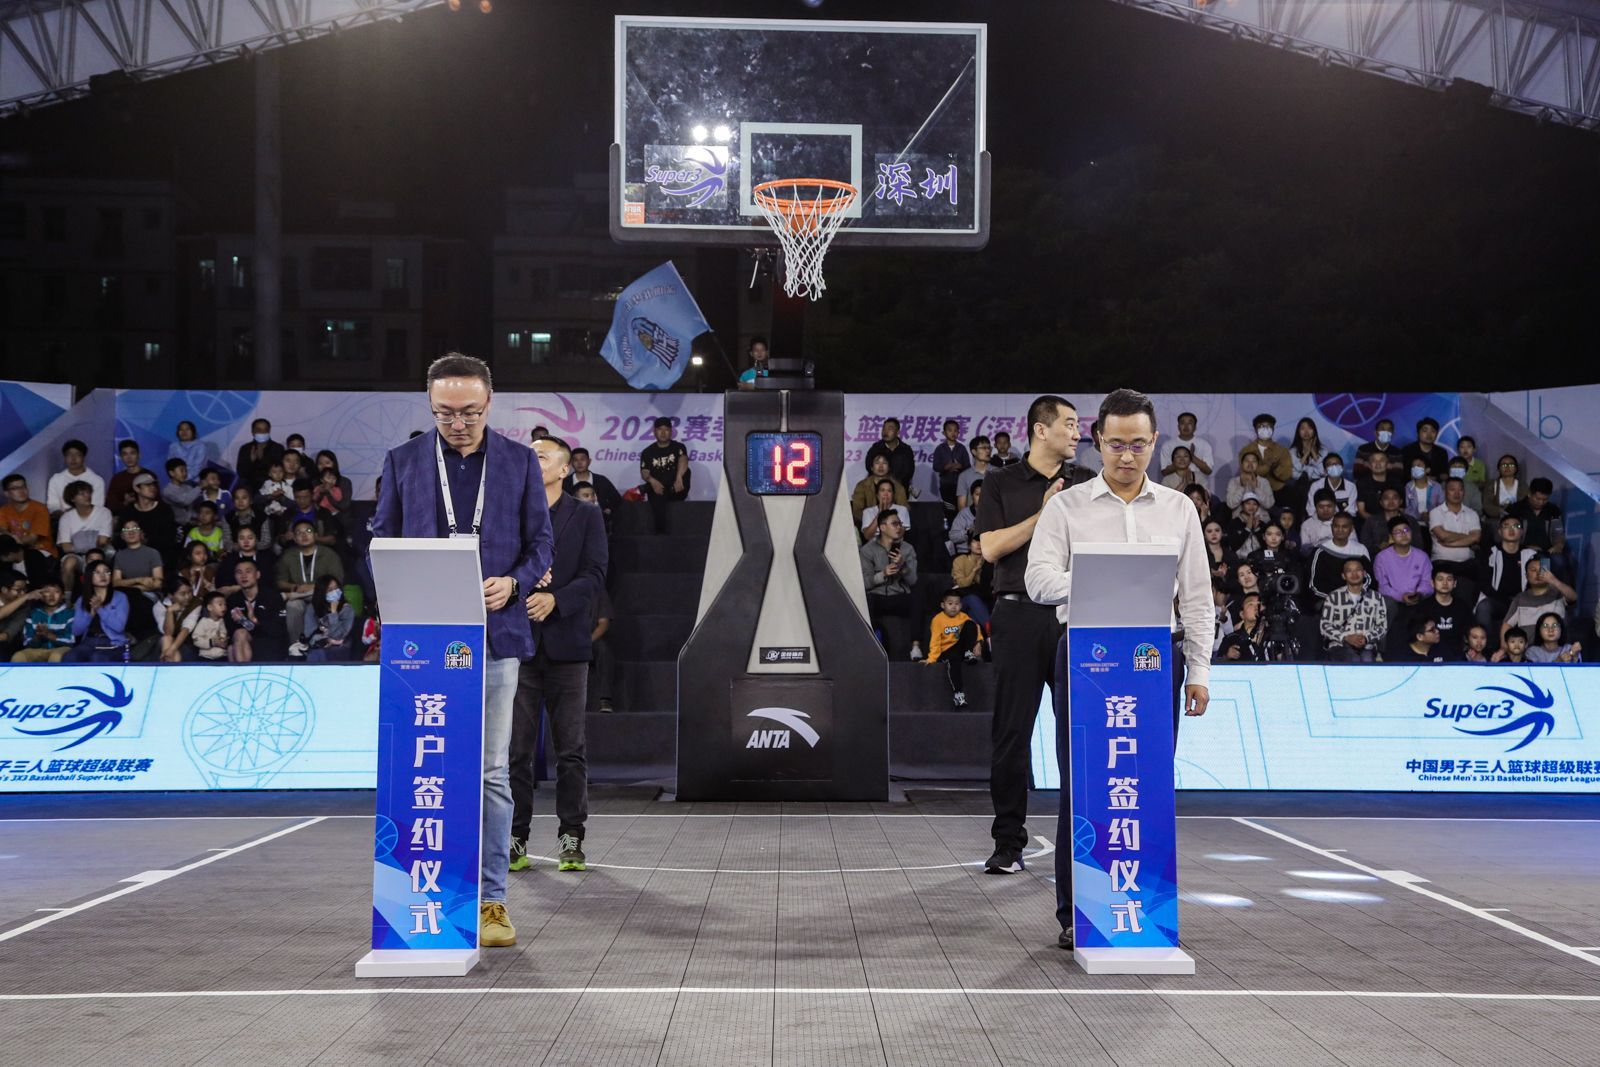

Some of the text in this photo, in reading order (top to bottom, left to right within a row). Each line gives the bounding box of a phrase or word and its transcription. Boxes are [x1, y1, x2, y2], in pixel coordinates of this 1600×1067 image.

[645, 165, 702, 186] Super3
[875, 162, 958, 206] 深圳
[595, 448, 641, 462] Chines
[689, 449, 723, 462] Bask
[772, 442, 811, 486] 12
[0, 698, 91, 722] Super3
[1424, 697, 1515, 722] Super3
[745, 730, 790, 748] ANTA
[77, 774, 101, 782] Super
[104, 774, 136, 782] League
[1418, 774, 1451, 782] Chinese
[1497, 775, 1542, 783] Basketball
[1543, 775, 1568, 783] Super
[1570, 775, 1600, 784] League
[409, 693, 447, 935] 落户签约仪式
[1105, 695, 1143, 933] 落户签约仪式
